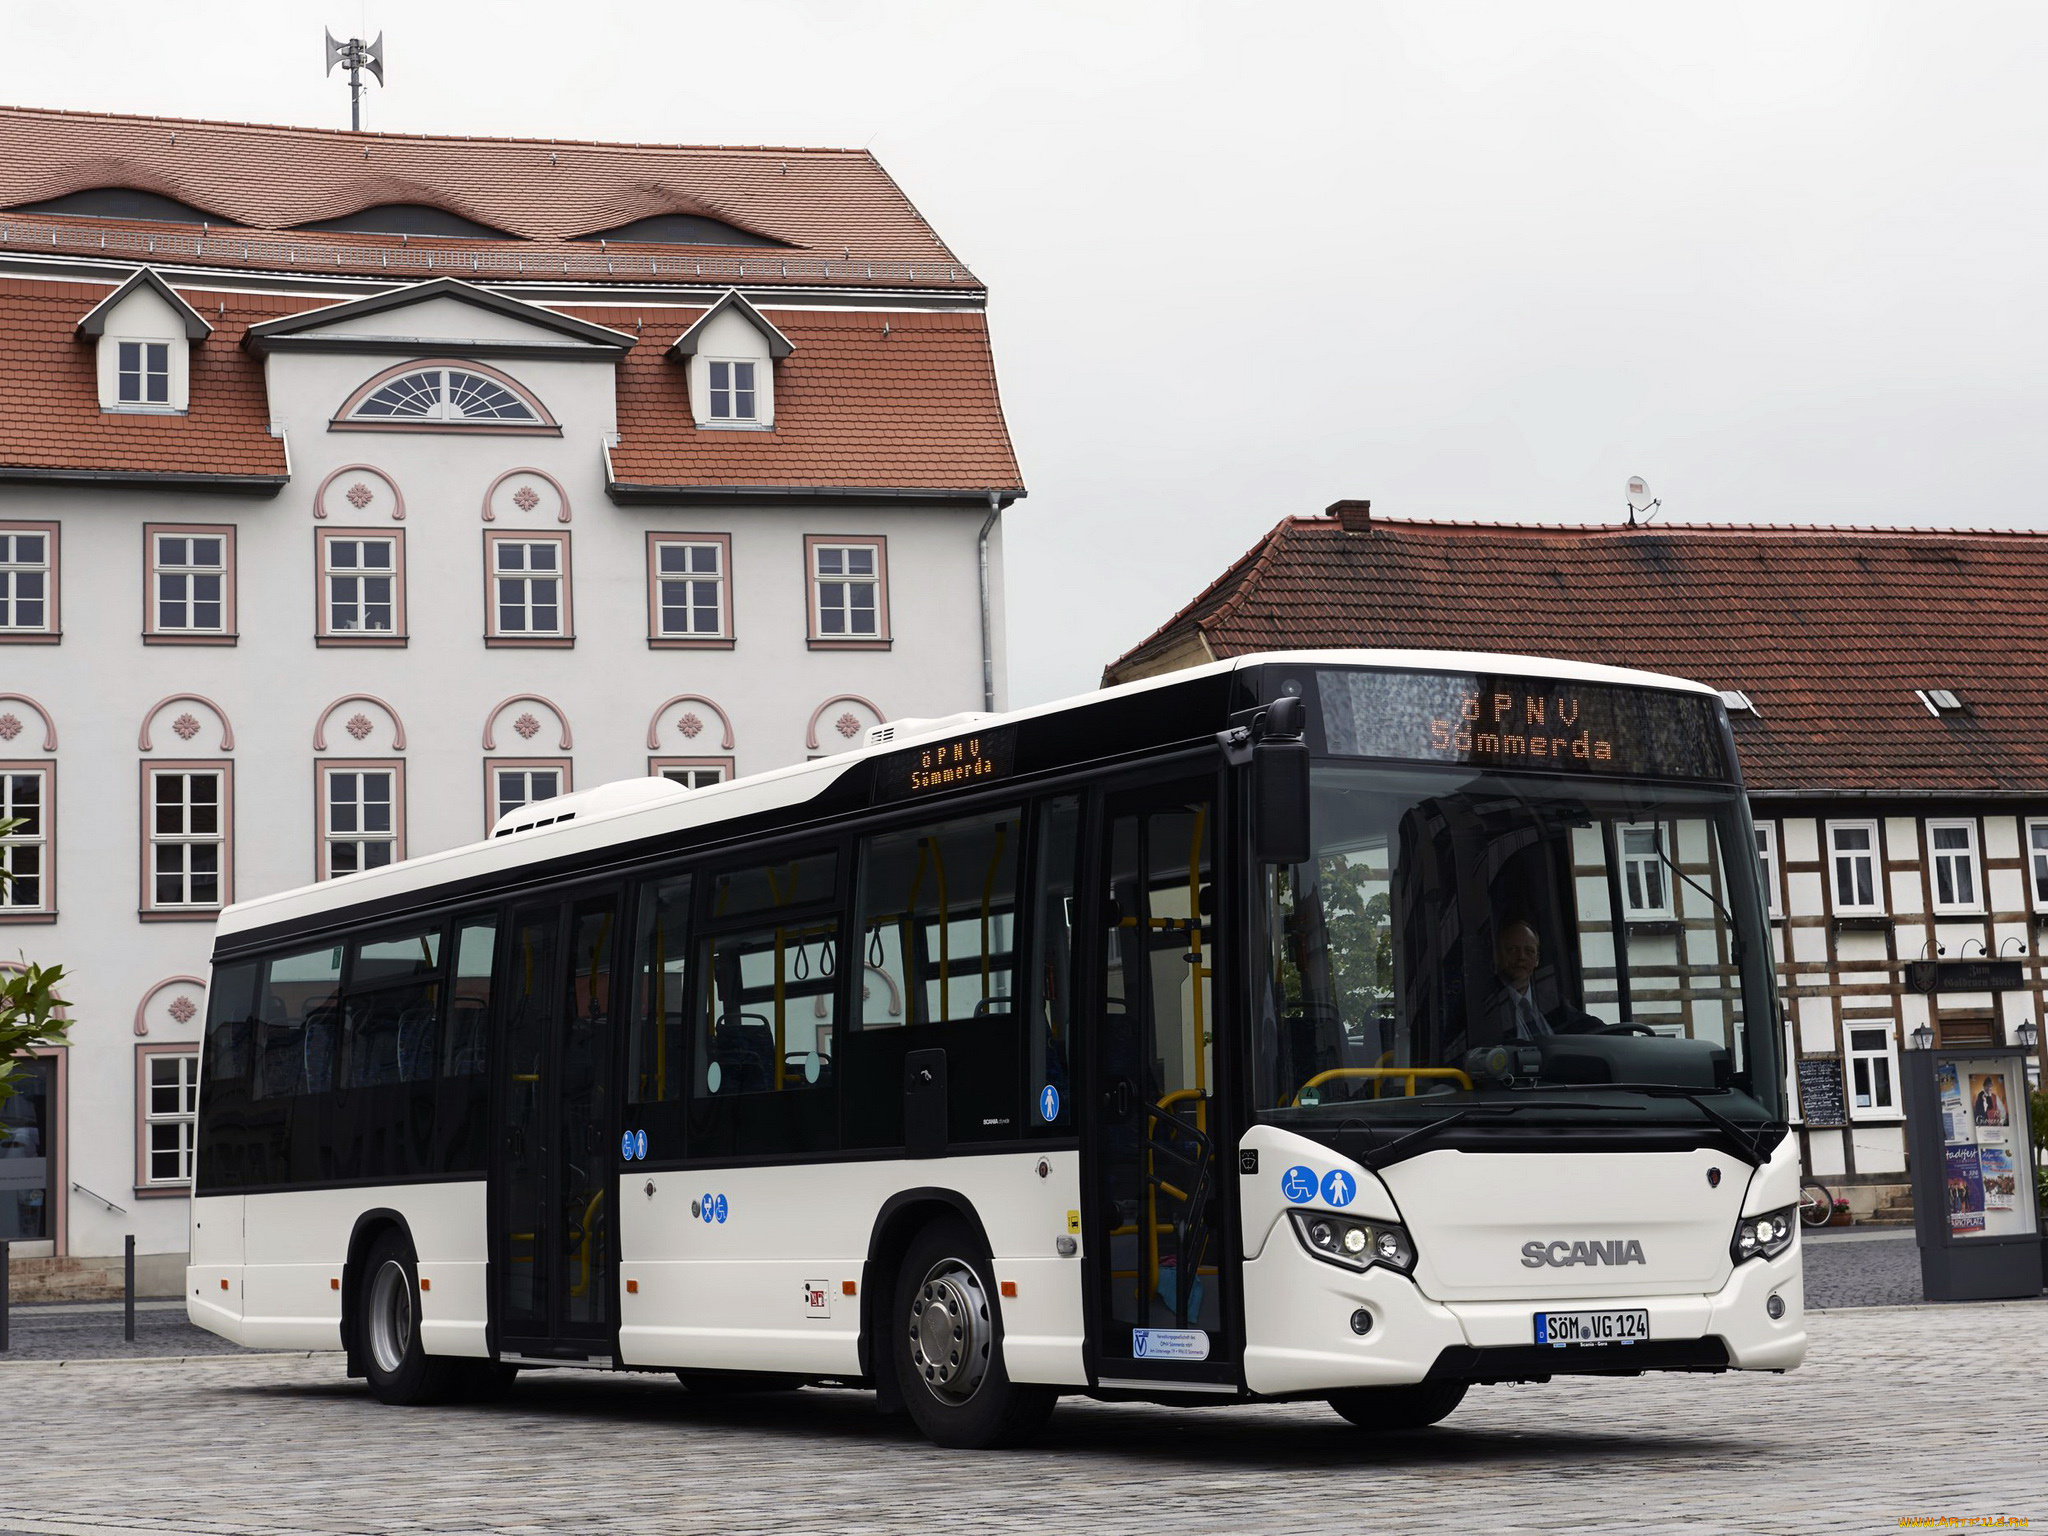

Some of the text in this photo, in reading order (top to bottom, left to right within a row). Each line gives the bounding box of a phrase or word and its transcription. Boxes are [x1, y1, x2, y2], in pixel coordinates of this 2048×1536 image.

[1431, 720, 1612, 760] Sömmerda
[911, 757, 992, 789] Sömmerda
[1968, 964, 1990, 977] Zum
[1306, 1087, 1313, 1098] 4
[1946, 1148, 1979, 1160] tadtfest
[1520, 1239, 1647, 1268] SCANIA
[1591, 1315, 1613, 1338] VG
[1615, 1314, 1646, 1337] 124
